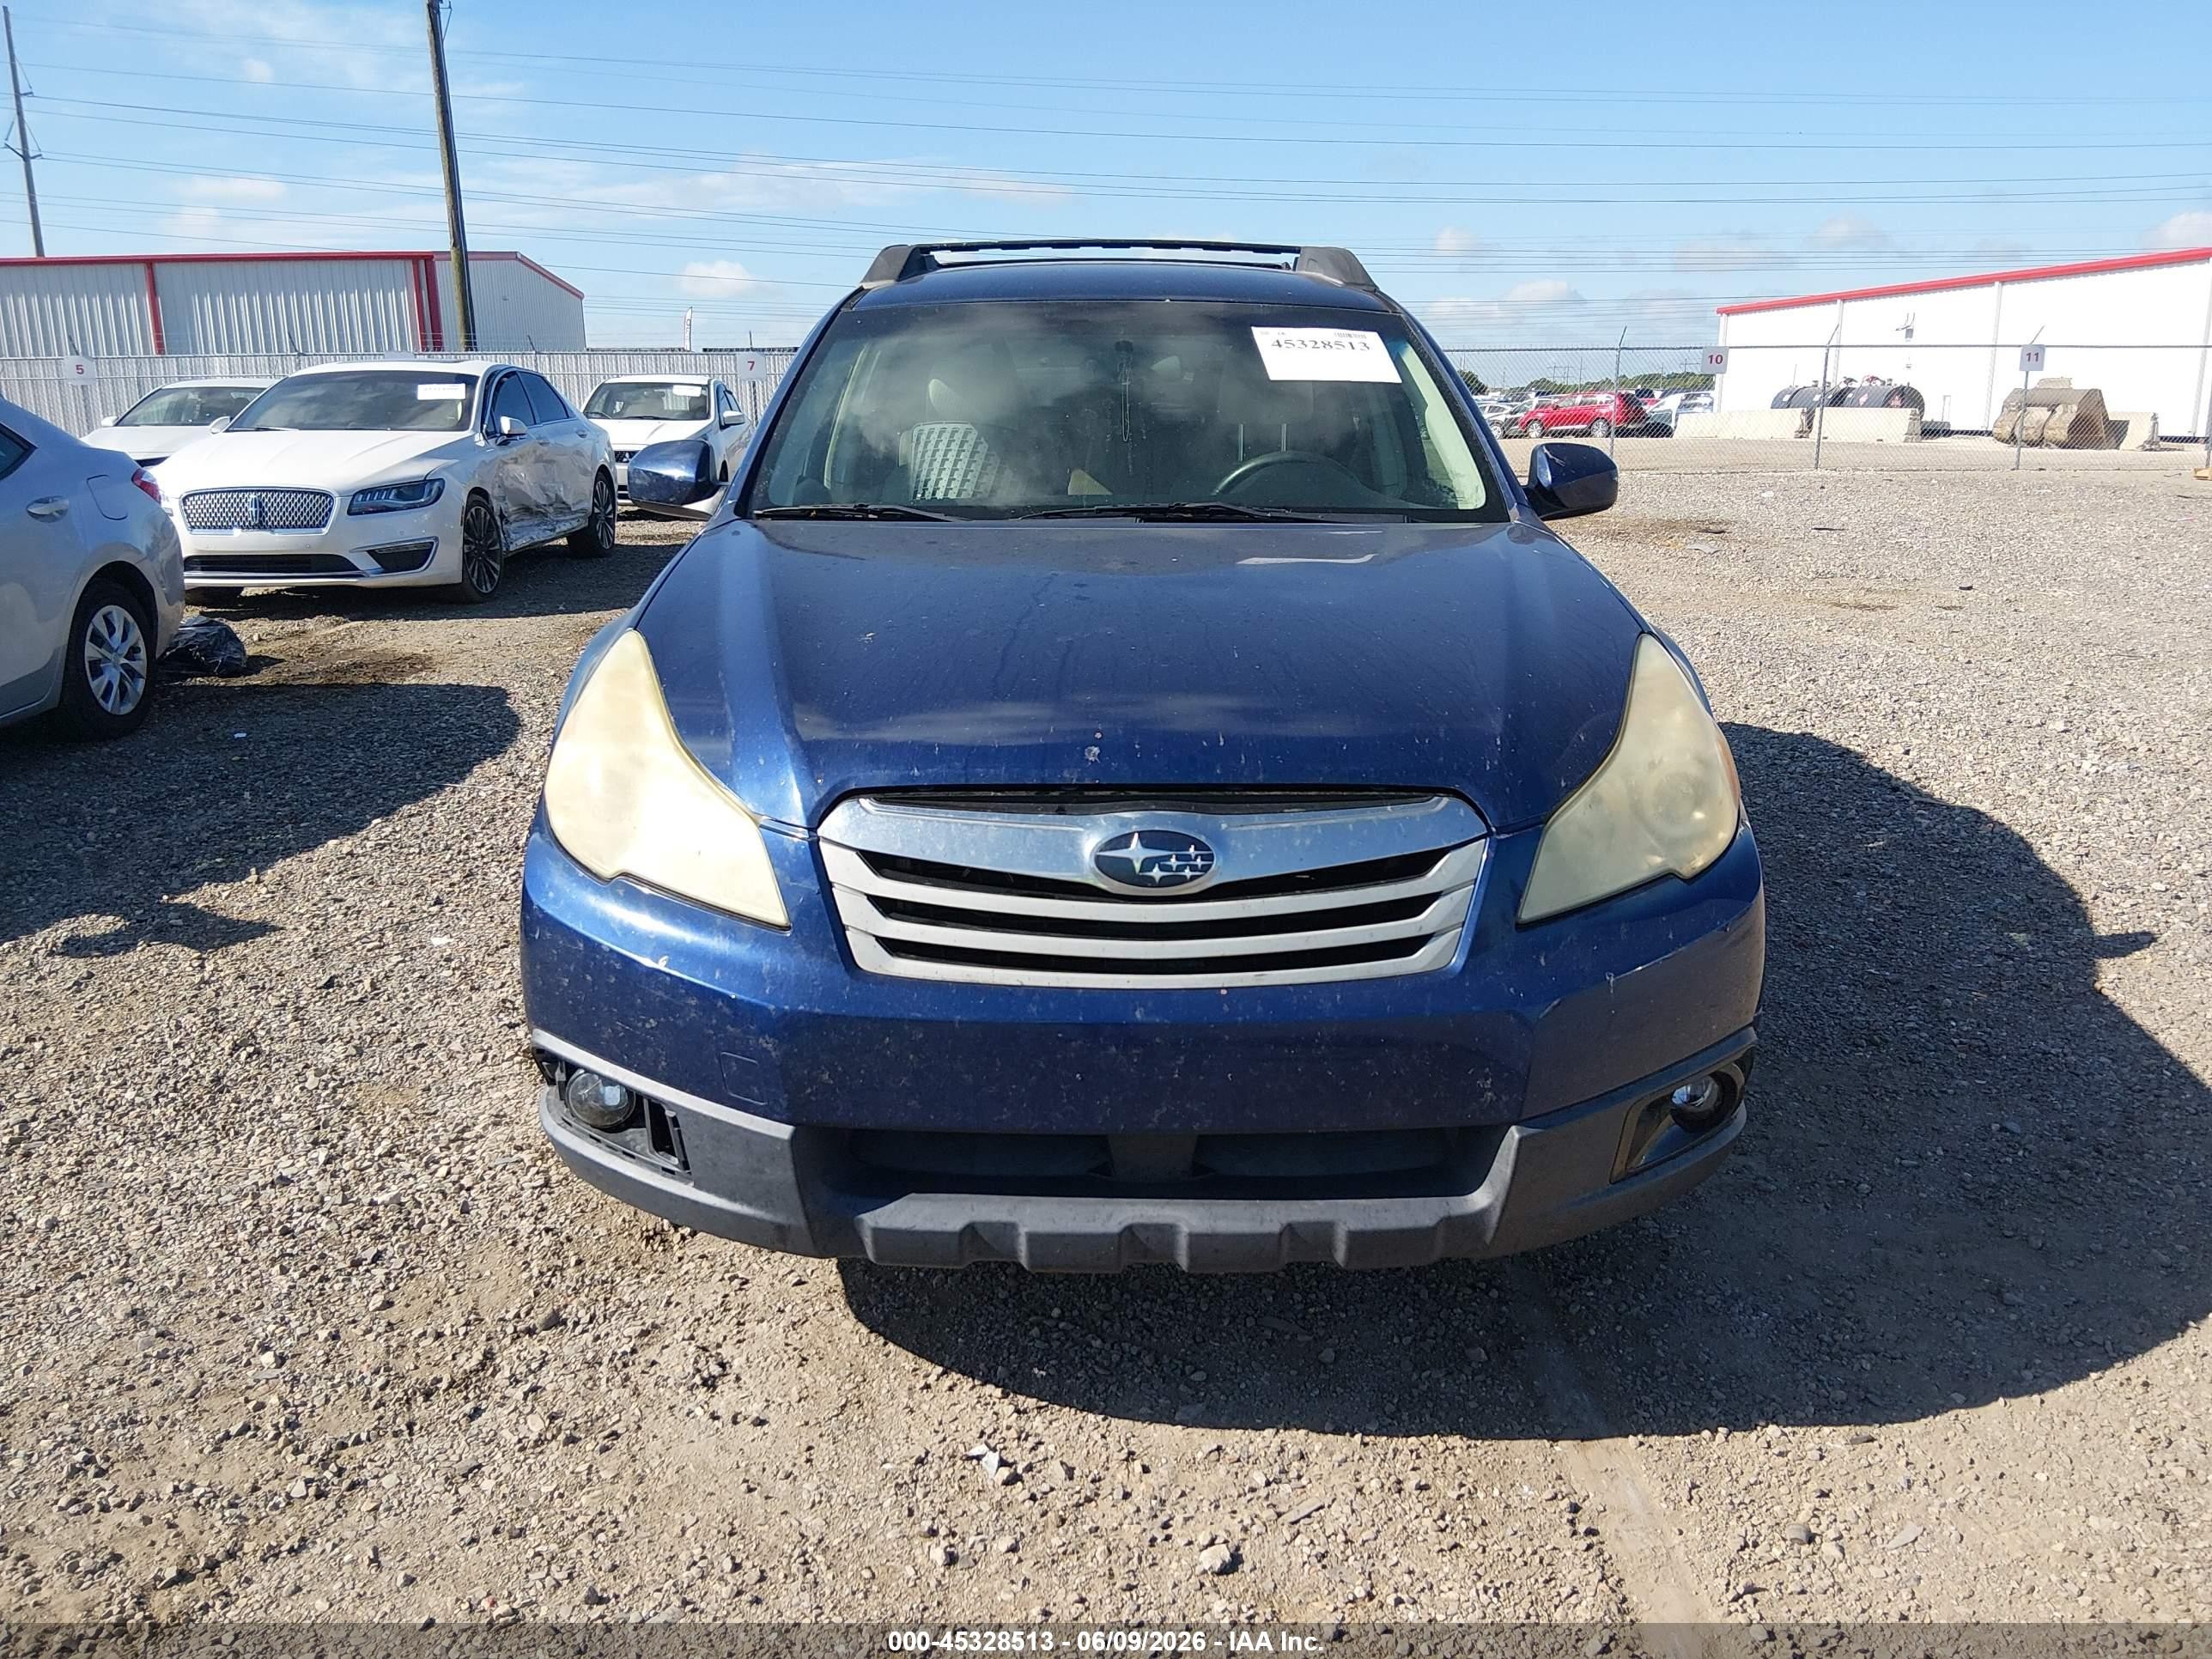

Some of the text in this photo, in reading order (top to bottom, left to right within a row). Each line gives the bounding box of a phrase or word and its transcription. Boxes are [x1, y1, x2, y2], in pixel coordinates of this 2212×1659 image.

[1271, 339, 1370, 351] 45328513
[1708, 354, 1723, 365] 10
[2027, 352, 2039, 362] 11
[76, 364, 84, 375] 5
[747, 361, 755, 372] 7
